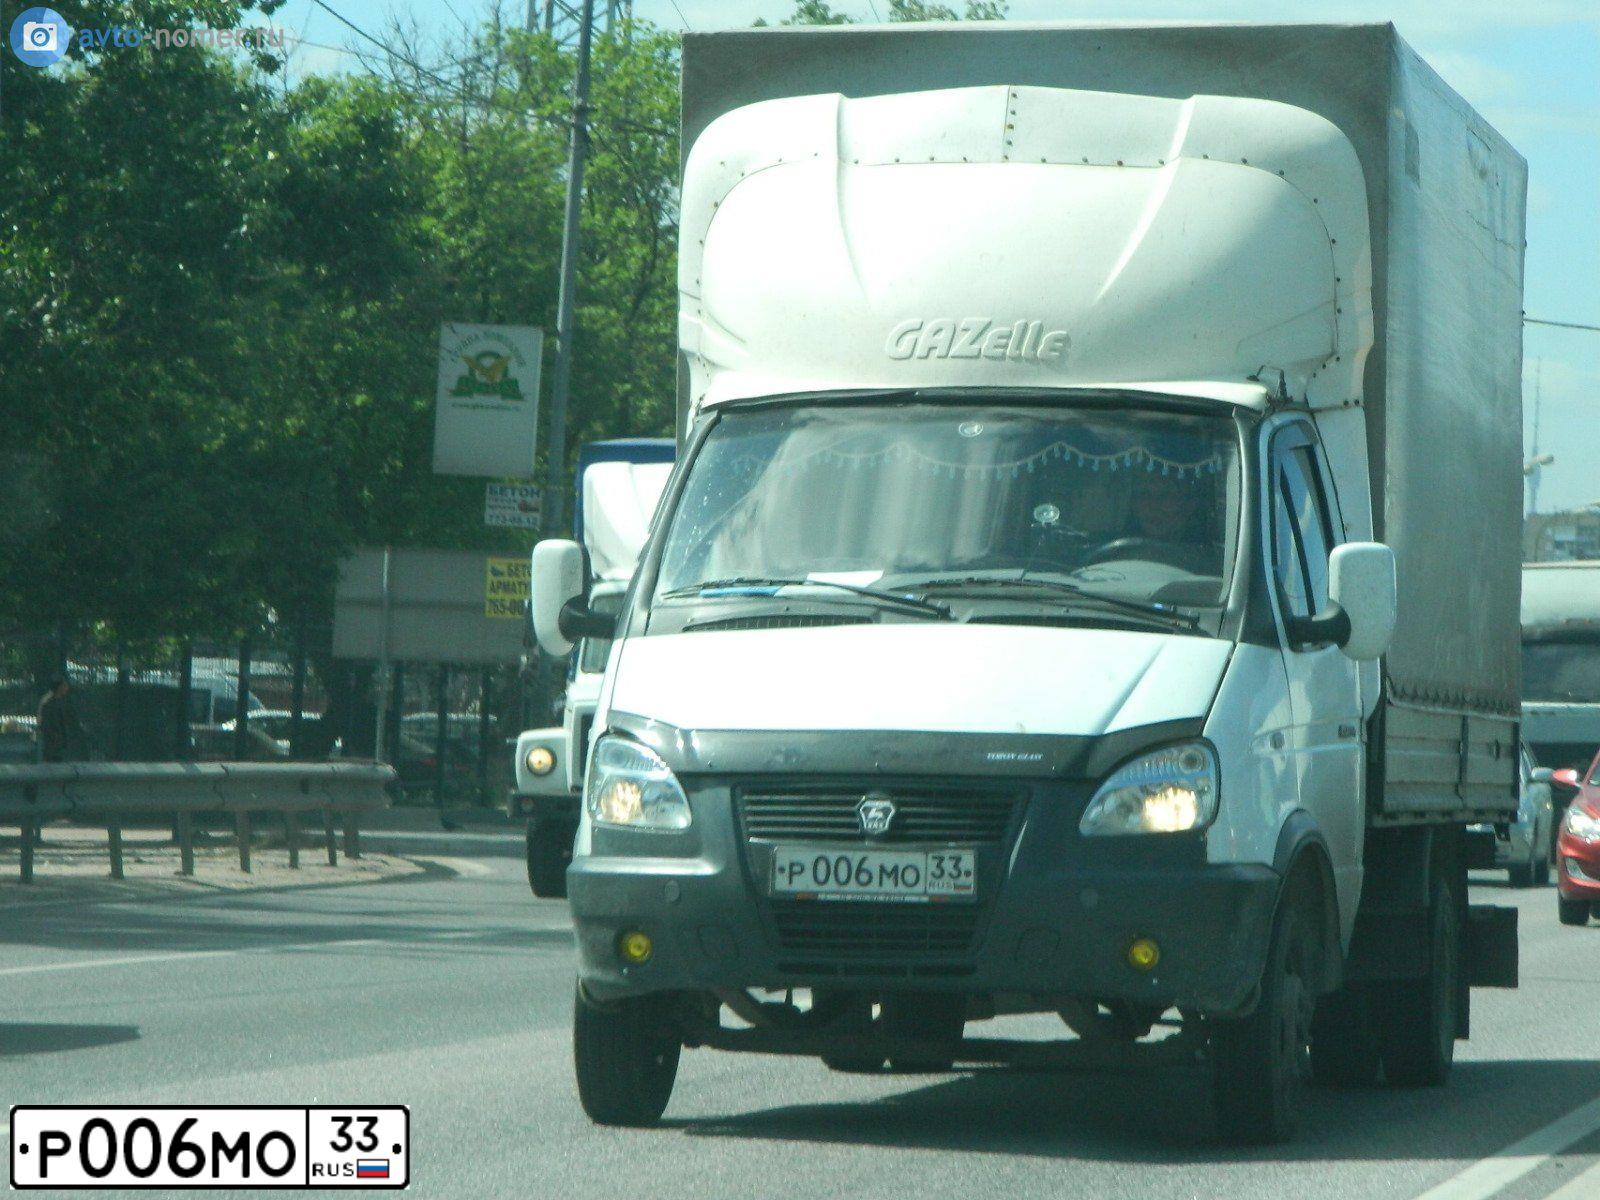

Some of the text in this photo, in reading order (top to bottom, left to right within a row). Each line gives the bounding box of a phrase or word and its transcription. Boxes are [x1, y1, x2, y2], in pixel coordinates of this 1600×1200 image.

[885, 317, 1071, 362] GAZelle
[489, 485, 540, 498] БЕТОН
[788, 855, 963, 887] Р006МО 33
